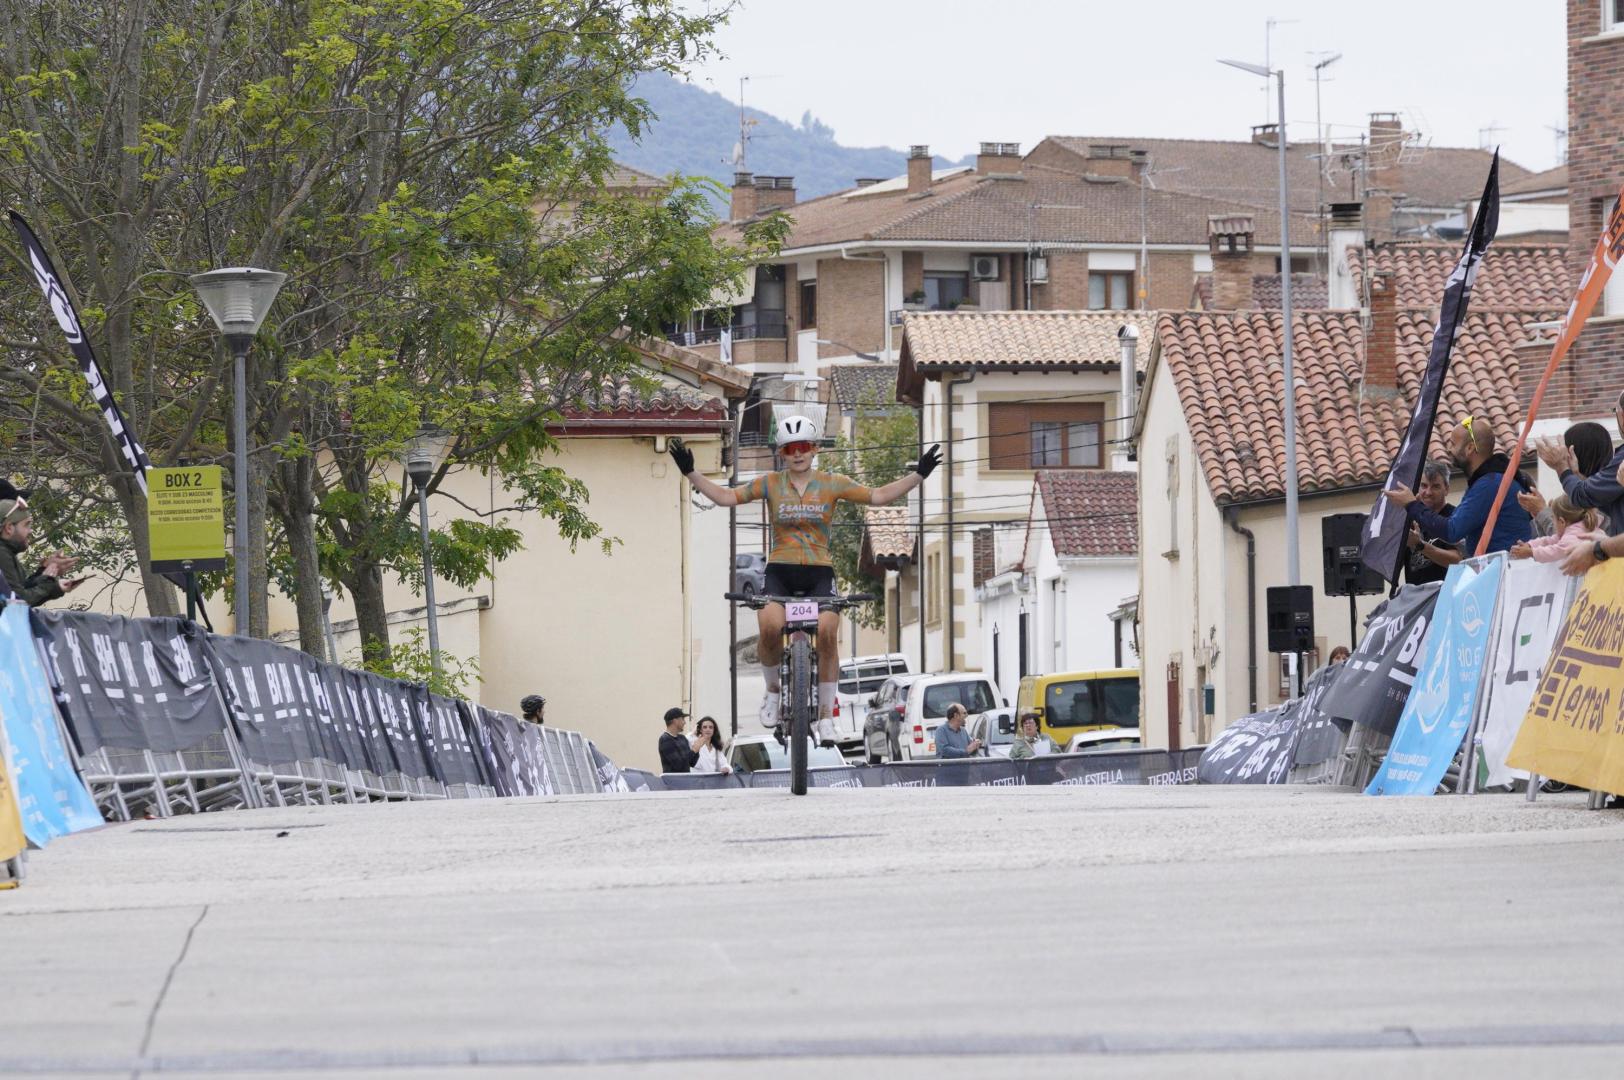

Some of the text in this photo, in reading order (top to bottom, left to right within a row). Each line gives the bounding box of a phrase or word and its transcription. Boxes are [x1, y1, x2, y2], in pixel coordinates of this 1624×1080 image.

[165, 472, 202, 487] BOX 2
[791, 606, 812, 616] 204
[1085, 769, 1123, 785] ESTELLA
[1147, 769, 1183, 785] TIERRA
